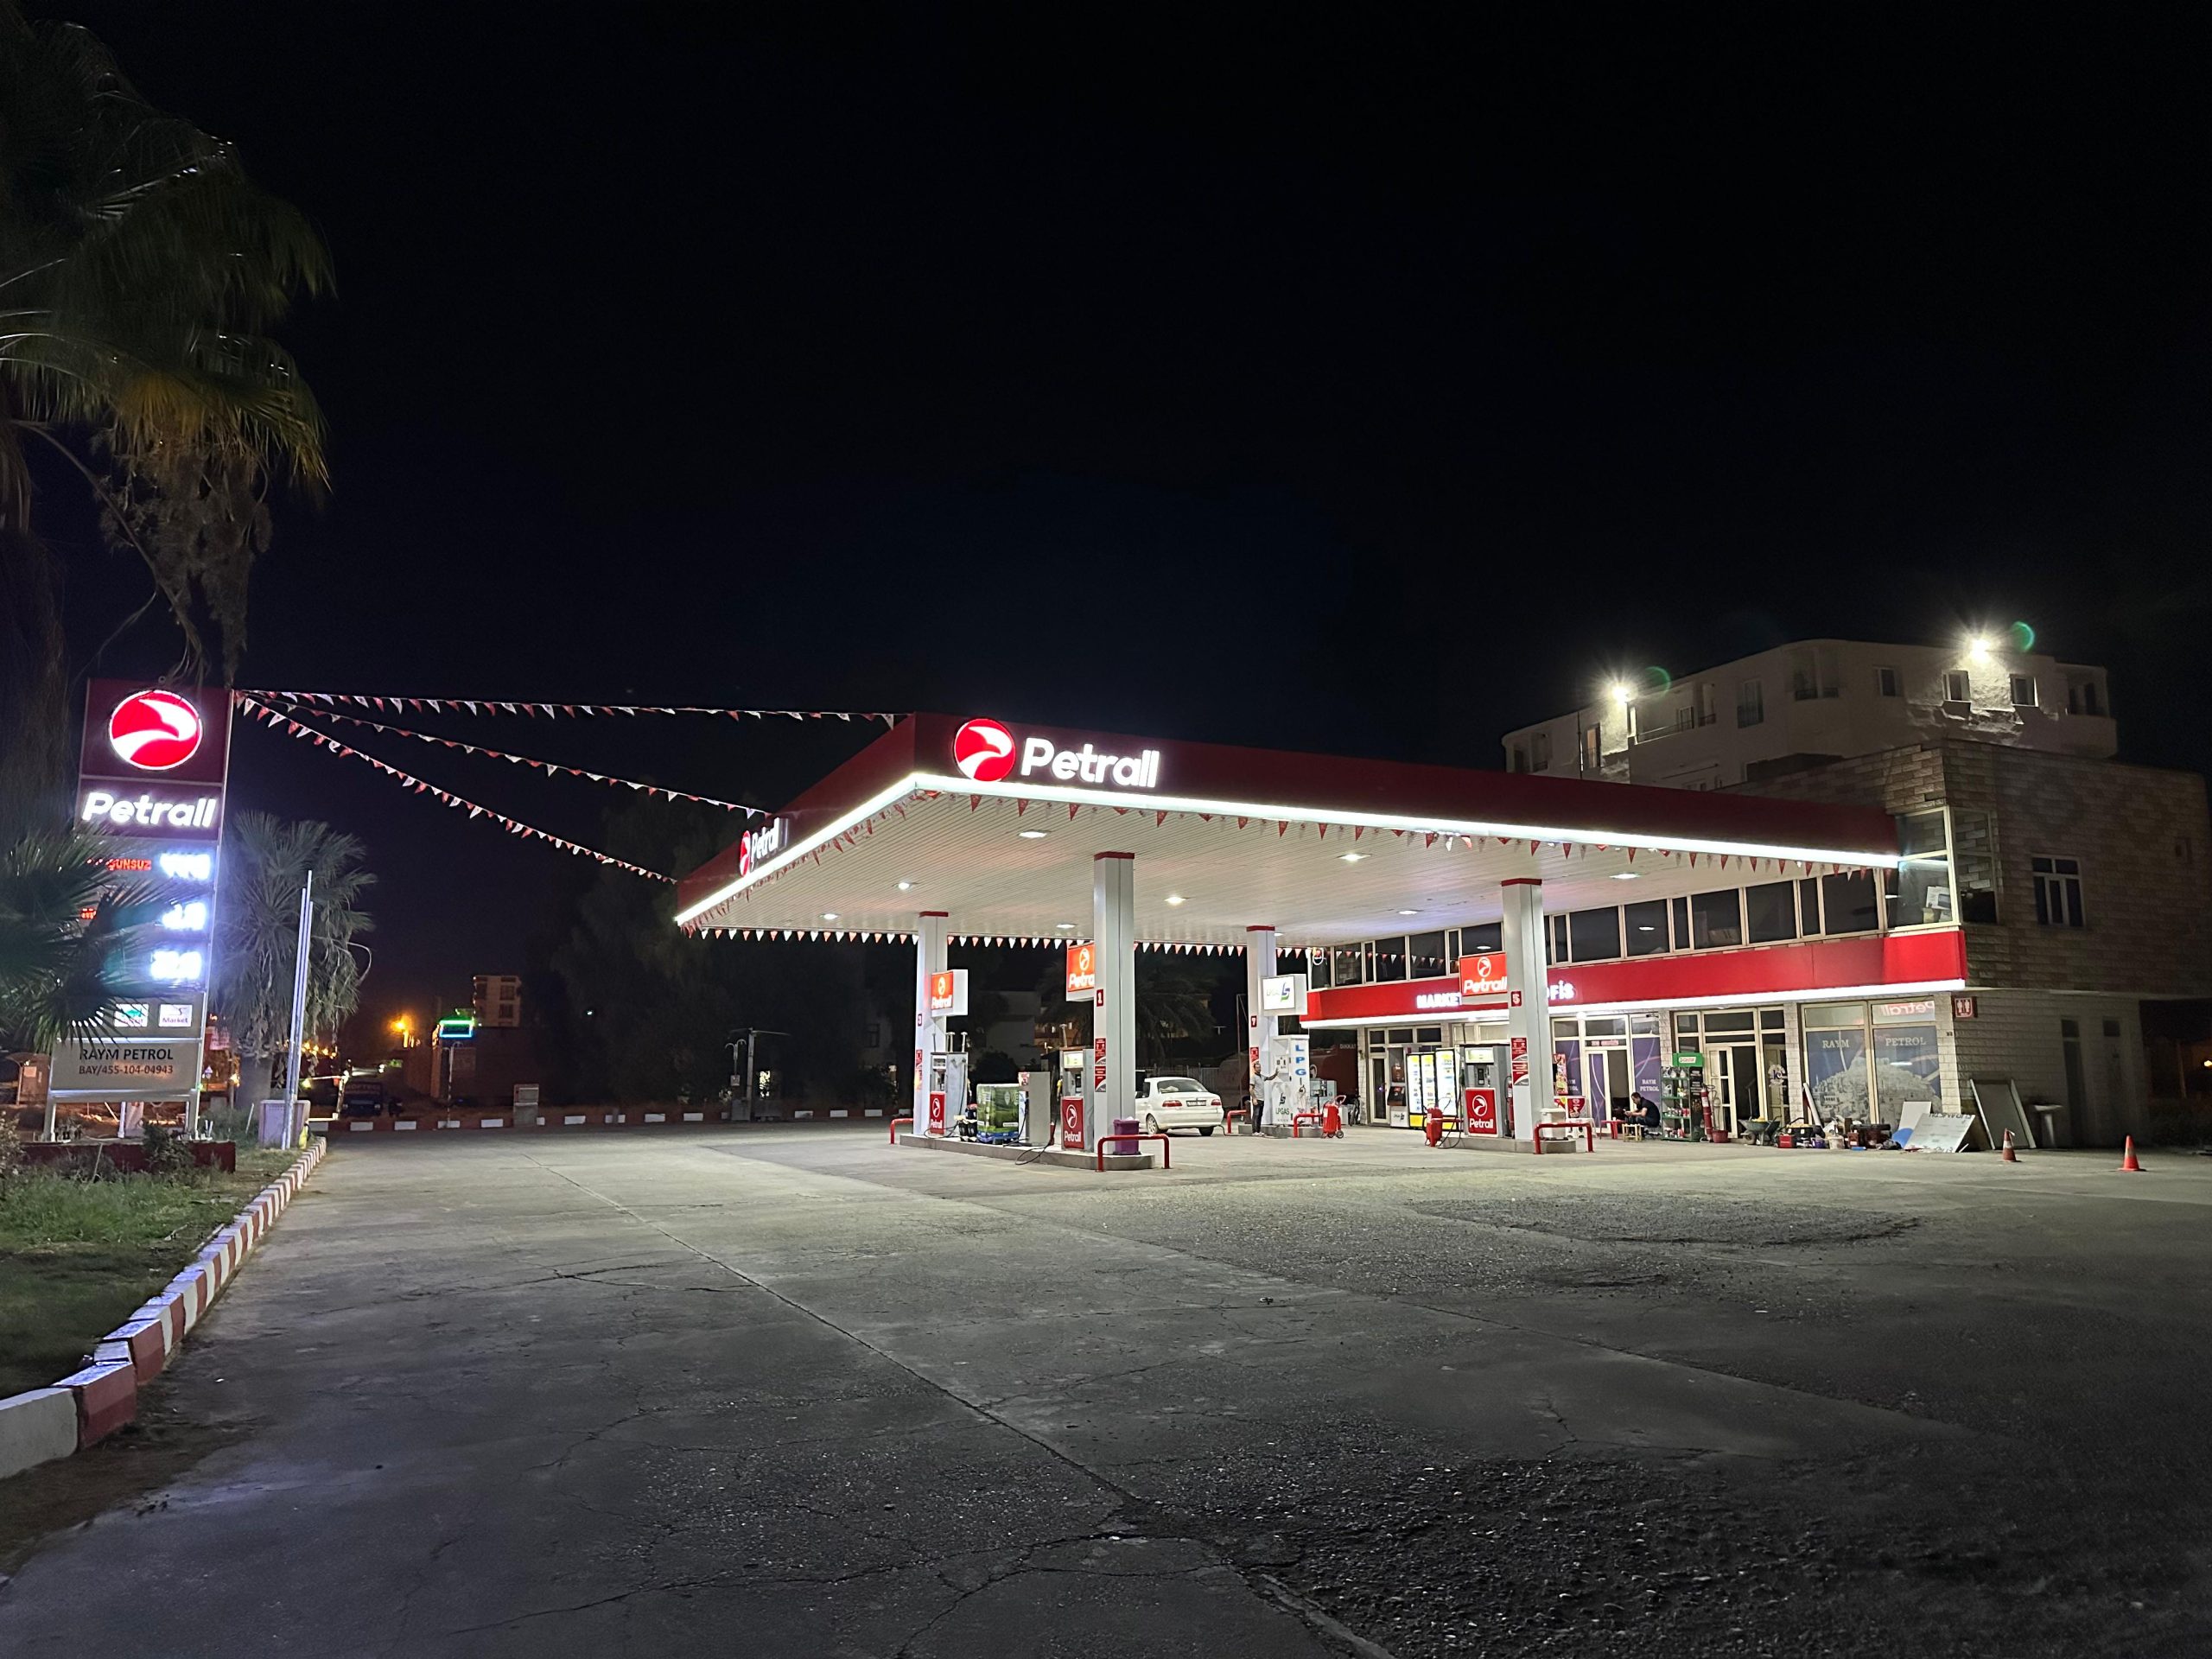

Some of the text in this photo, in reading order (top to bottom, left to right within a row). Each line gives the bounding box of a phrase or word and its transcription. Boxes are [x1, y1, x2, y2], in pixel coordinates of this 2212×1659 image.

[1020, 737, 1160, 788] Petrall
[82, 792, 217, 828] Petrall
[1464, 977, 1507, 994] Petrall
[1097, 992, 1103, 1004] 1
[1512, 994, 1521, 1005] 5
[1251, 1017, 1256, 1027] 7
[1822, 1037, 1927, 1049] RAYM PETROL
[79, 1048, 174, 1060] RAYM PETROL
[79, 1065, 174, 1077] BAY/455-104-04943
[1470, 1118, 1493, 1128] Petrall
[1064, 1130, 1082, 1142] Petrall
